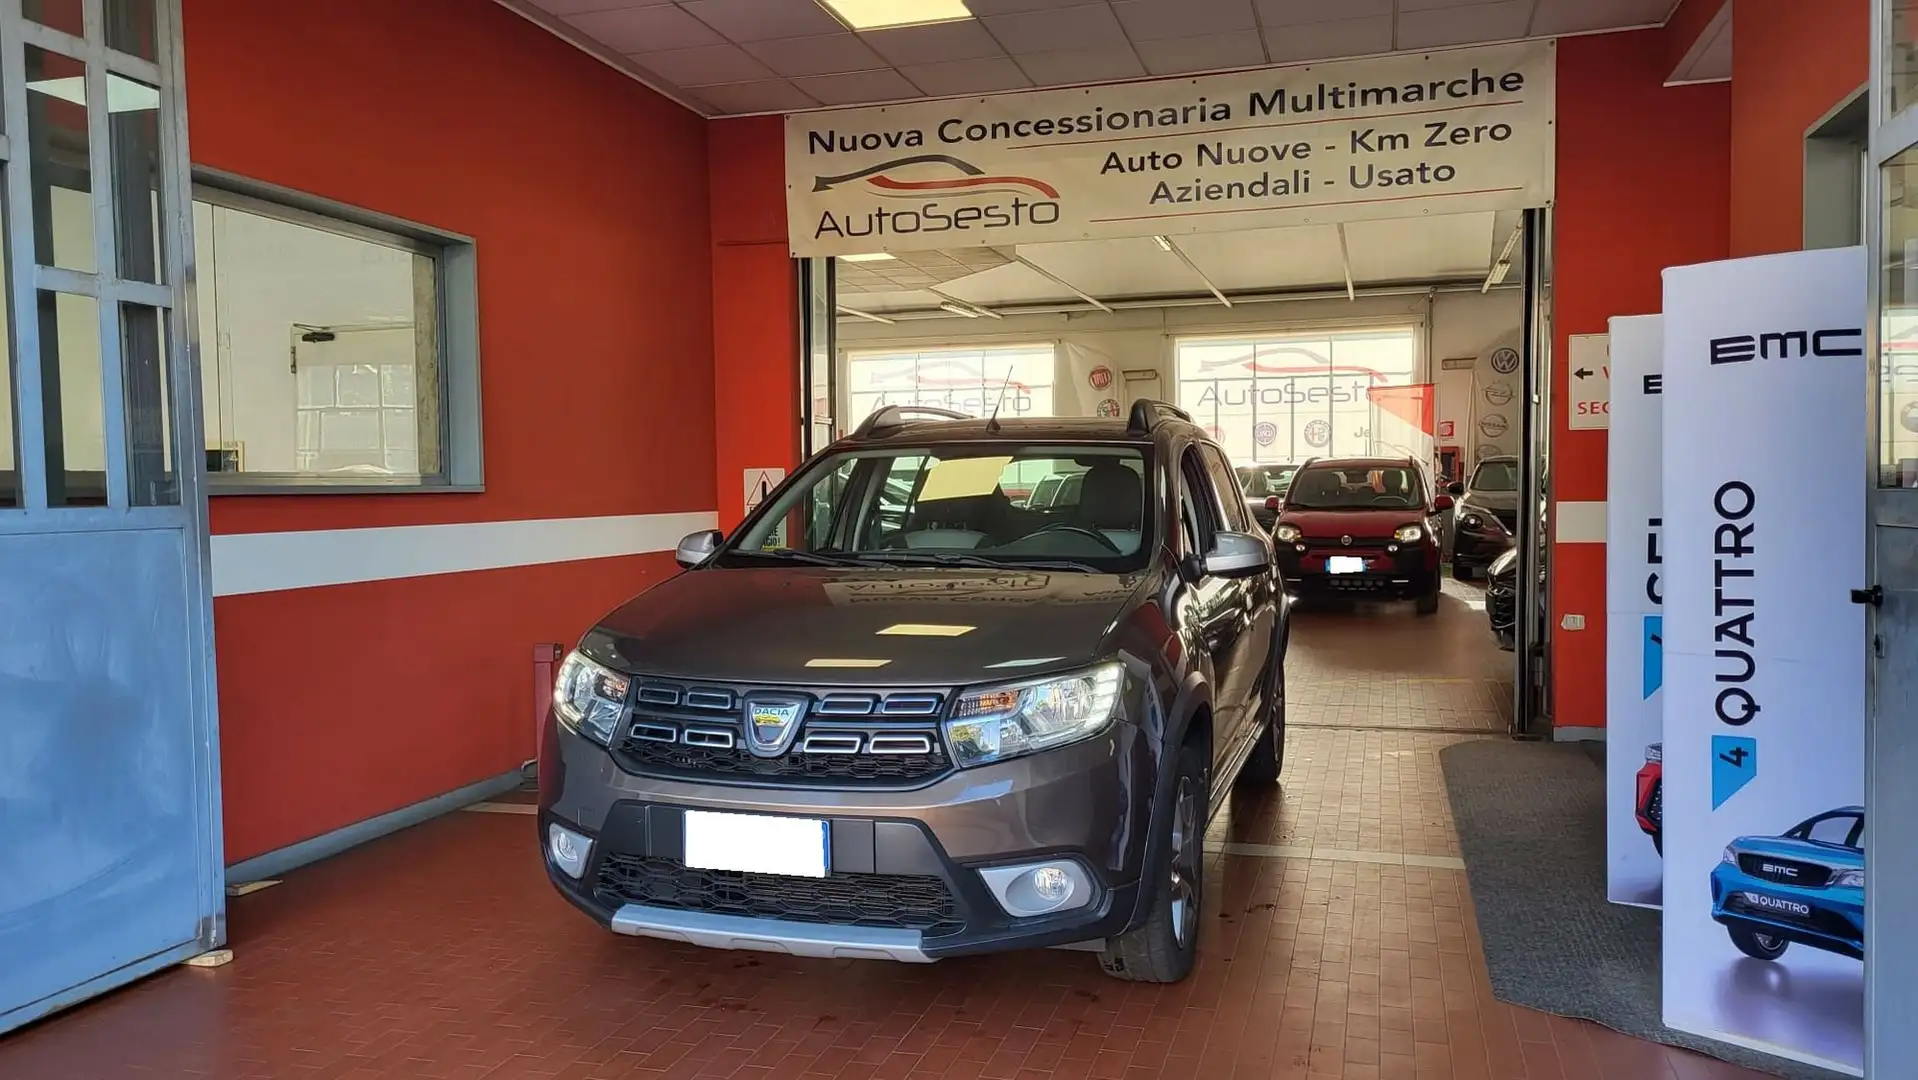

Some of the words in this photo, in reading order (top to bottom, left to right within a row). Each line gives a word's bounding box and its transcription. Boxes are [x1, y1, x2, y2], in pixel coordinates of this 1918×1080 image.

[808, 129, 924, 155] Nuova
[938, 97, 1231, 144] Concessionaria
[1249, 68, 1525, 117] Multimarche
[1100, 151, 1184, 175] Auto
[1197, 141, 1312, 167] Nuove
[1351, 128, 1410, 154] Km
[1424, 121, 1513, 148] Zero
[1149, 169, 1311, 205] Aziendali
[1350, 162, 1456, 189] Usato
[814, 197, 1061, 240] AutoSesto
[1197, 380, 1373, 406] AutoSest
[1354, 426, 1371, 438] Je
[1713, 480, 1761, 727] QUATTRO
[754, 708, 790, 716] DACIA
[1719, 745, 1749, 769] 4
[1760, 896, 1810, 915] QUATTRO
